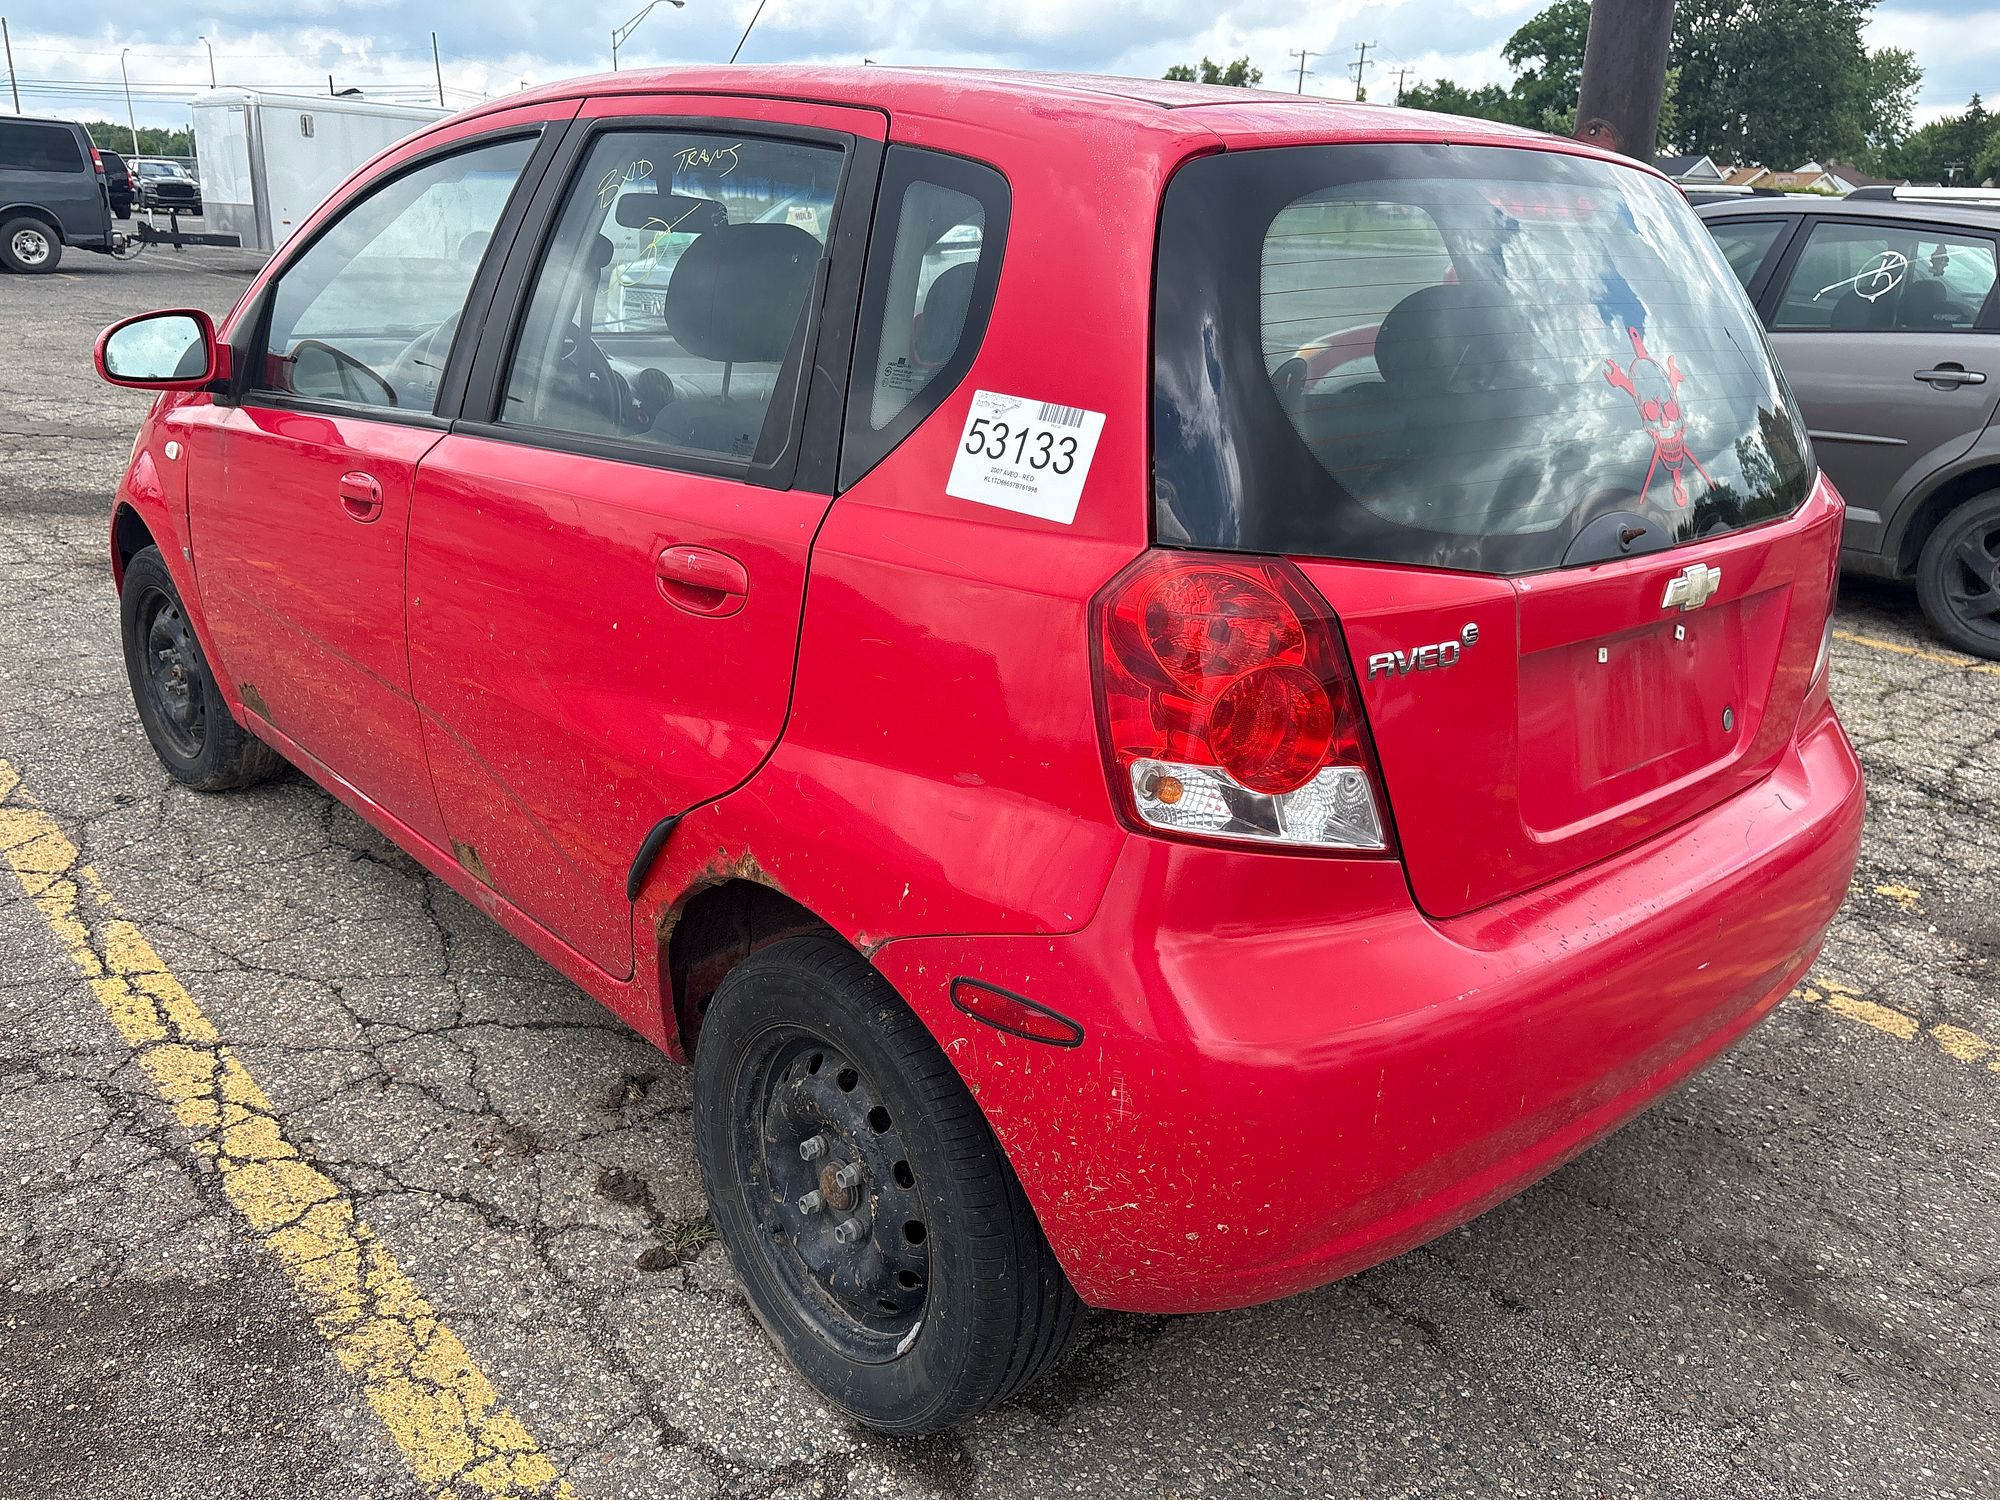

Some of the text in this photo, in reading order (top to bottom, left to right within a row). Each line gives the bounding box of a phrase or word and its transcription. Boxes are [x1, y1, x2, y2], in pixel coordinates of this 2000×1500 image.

[598, 143, 742, 210] BAD TRANS
[965, 418, 1078, 475] 53133
[990, 466, 1003, 475] 2007
[1003, 469, 1018, 479] AVEO
[1022, 473, 1035, 482] RED
